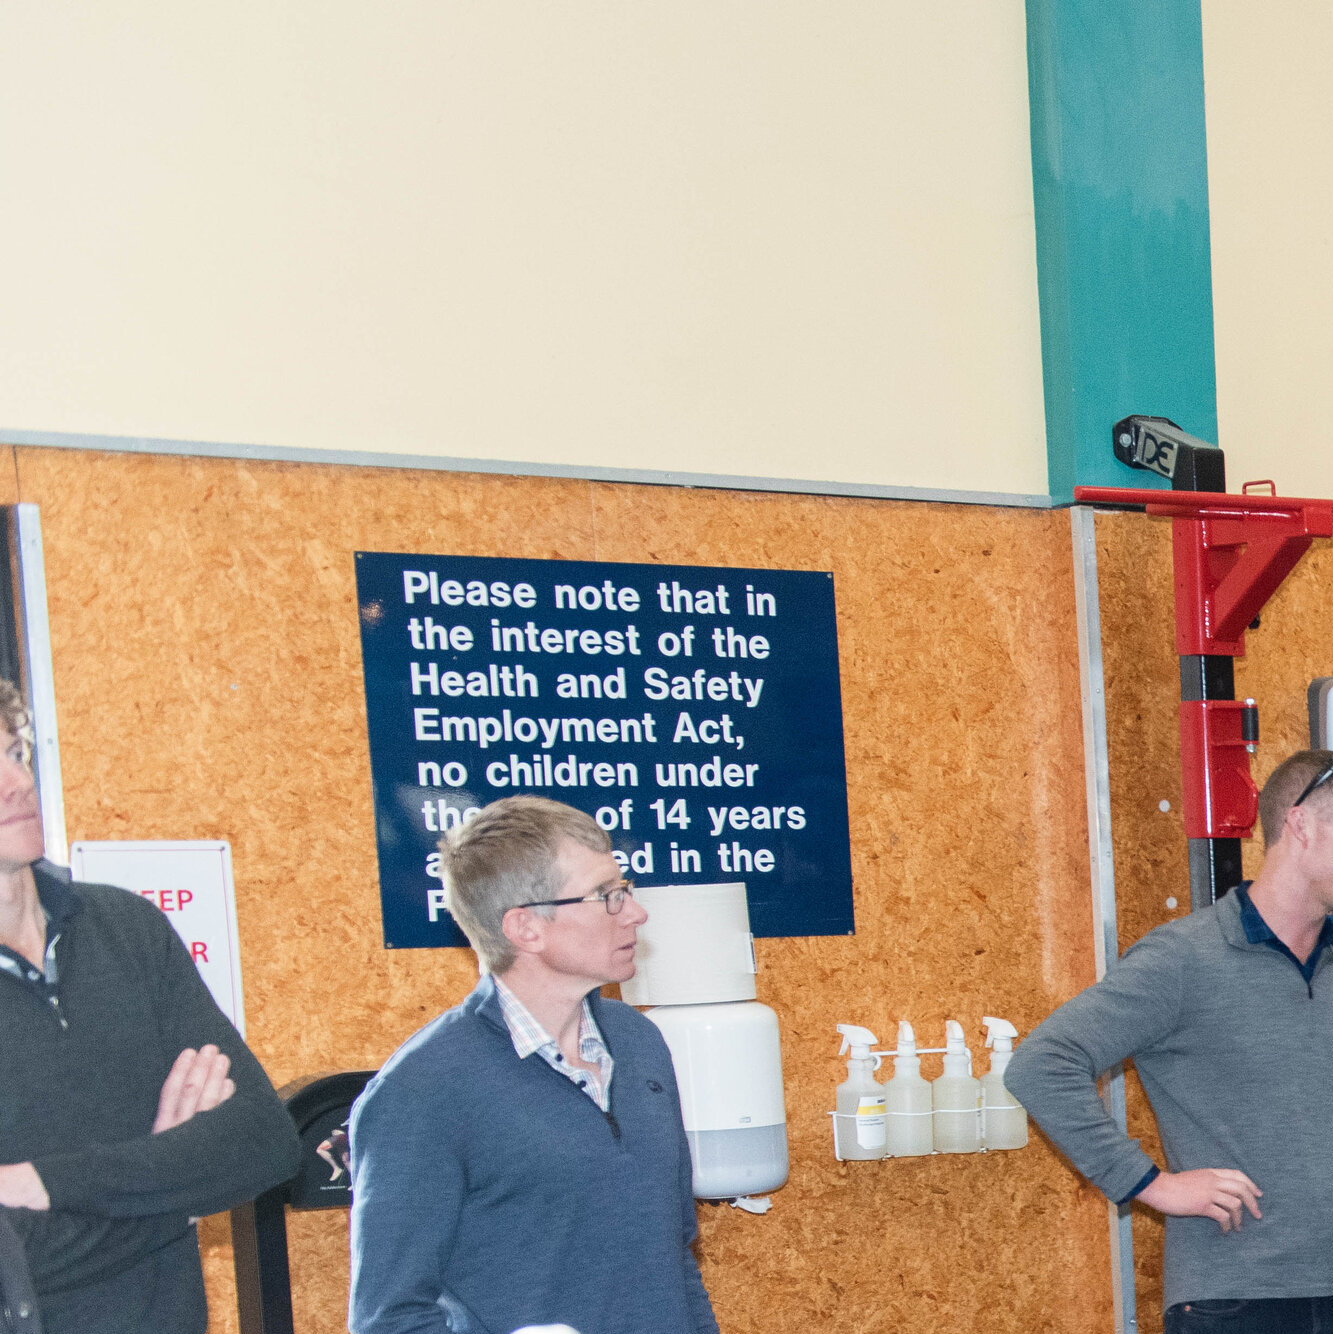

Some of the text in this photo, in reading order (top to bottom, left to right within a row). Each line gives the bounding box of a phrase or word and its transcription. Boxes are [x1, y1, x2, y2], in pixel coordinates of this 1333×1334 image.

[403, 570, 777, 617] Please note that in
[407, 617, 770, 660] the interest of the
[410, 662, 764, 708] Health and Safety
[413, 707, 745, 750] Employment Act,
[417, 754, 759, 788] no children under
[595, 798, 634, 831] of
[649, 798, 691, 830] 14
[707, 806, 806, 837] years
[670, 841, 702, 873] in
[717, 842, 775, 873] the
